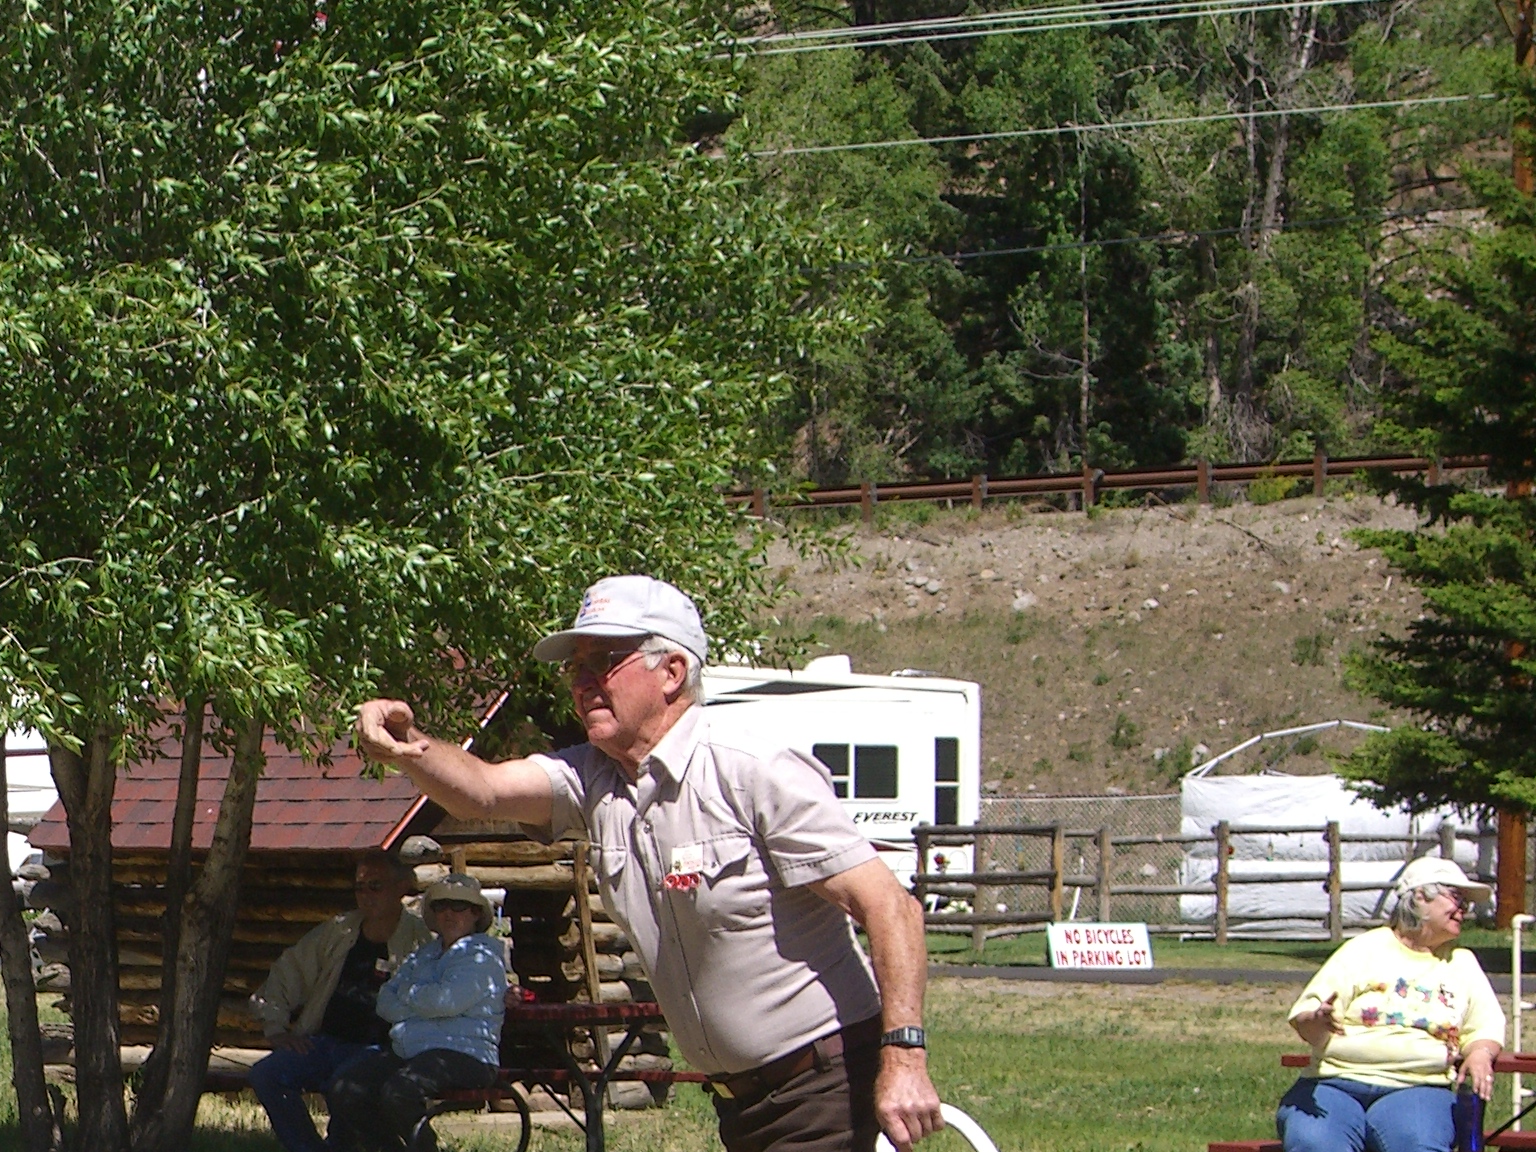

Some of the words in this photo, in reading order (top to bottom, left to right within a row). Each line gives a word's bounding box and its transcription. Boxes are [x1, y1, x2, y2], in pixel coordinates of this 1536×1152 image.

[853, 811, 918, 824] EVEREST
[1064, 929, 1081, 944] NO
[1085, 929, 1135, 944] BICYCLES
[1056, 950, 1069, 966] IN
[1072, 950, 1123, 966] PARKING
[1127, 950, 1147, 965] LOT
